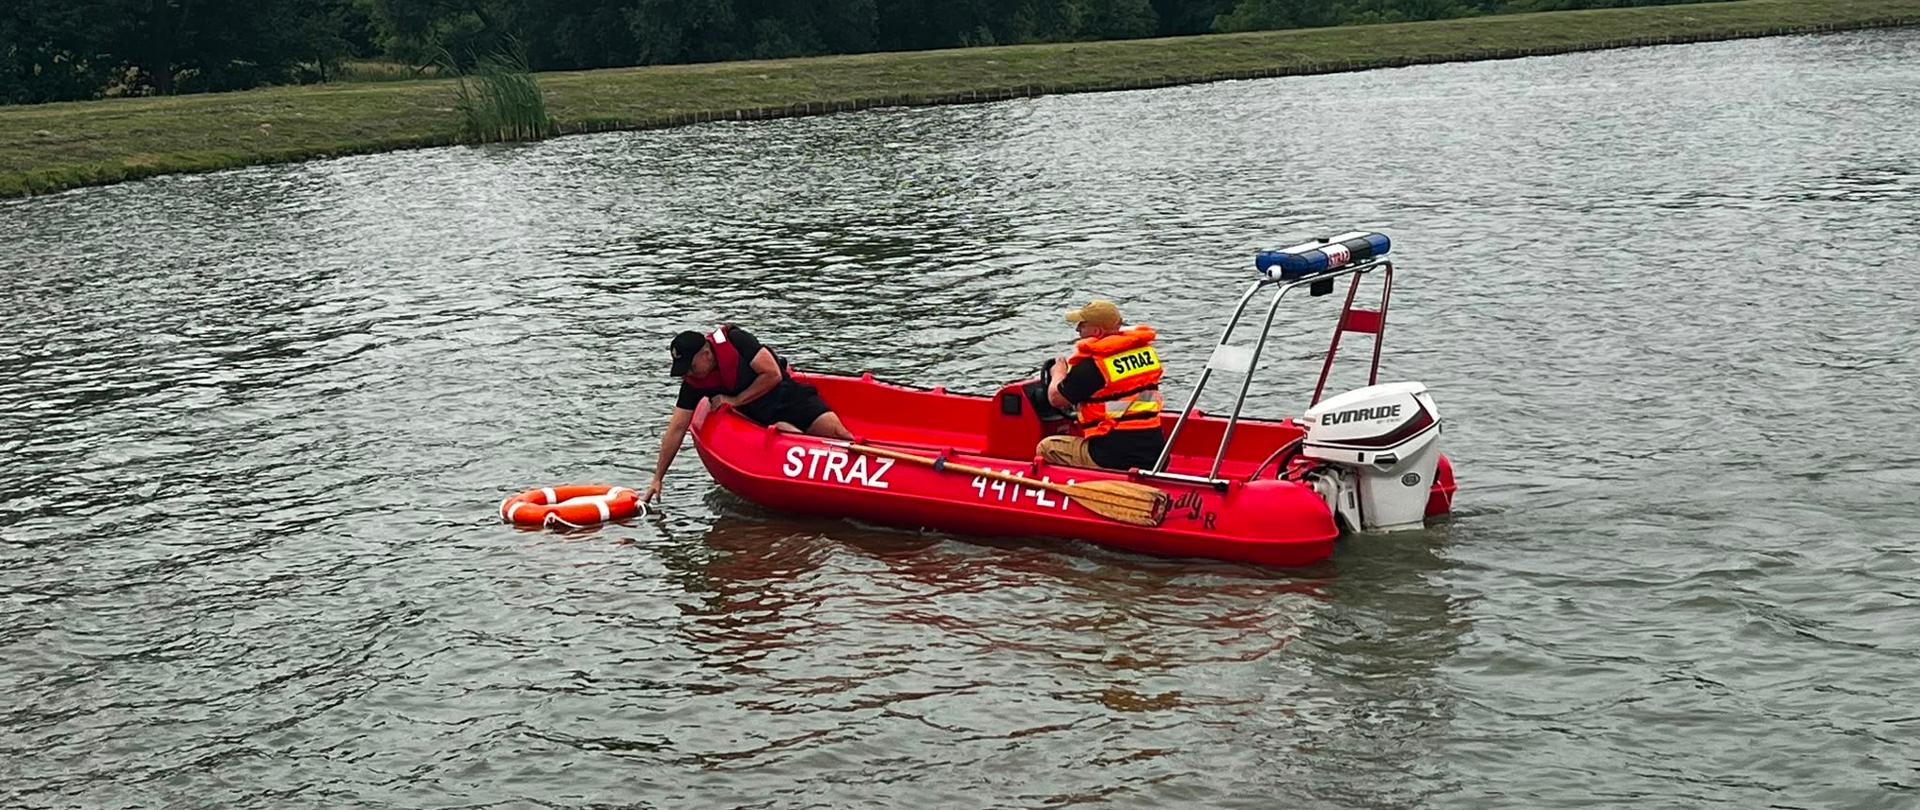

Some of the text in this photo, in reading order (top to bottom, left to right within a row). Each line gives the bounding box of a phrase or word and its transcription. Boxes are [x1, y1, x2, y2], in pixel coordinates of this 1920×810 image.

[1113, 351, 1154, 374] STRAZ
[1322, 404, 1401, 426] EVINRUDE
[783, 446, 896, 488] STRAZ
